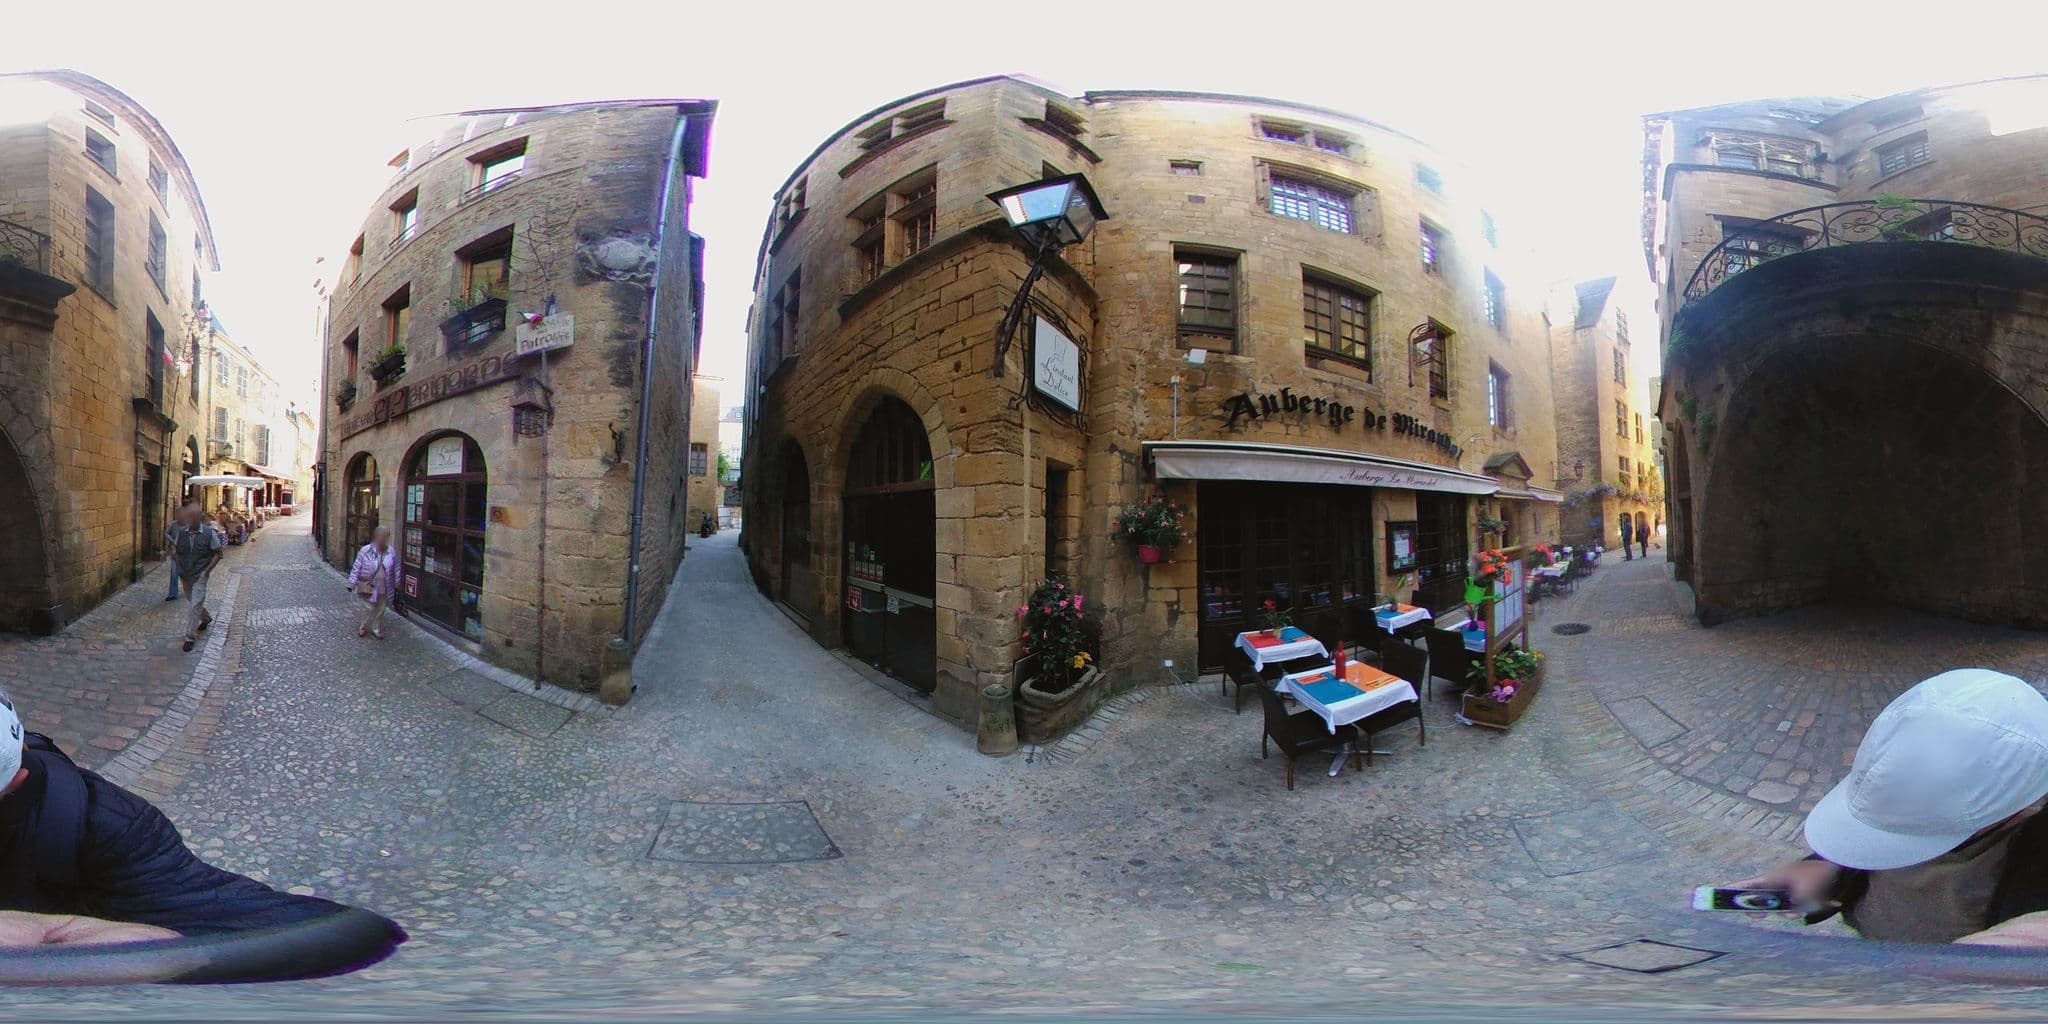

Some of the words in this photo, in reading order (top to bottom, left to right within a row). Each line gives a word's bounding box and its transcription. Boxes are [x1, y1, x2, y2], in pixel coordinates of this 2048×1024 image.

[1221, 387, 1355, 430] Auberge
[1364, 407, 1387, 430] de
[1340, 469, 1384, 484] Auberge
